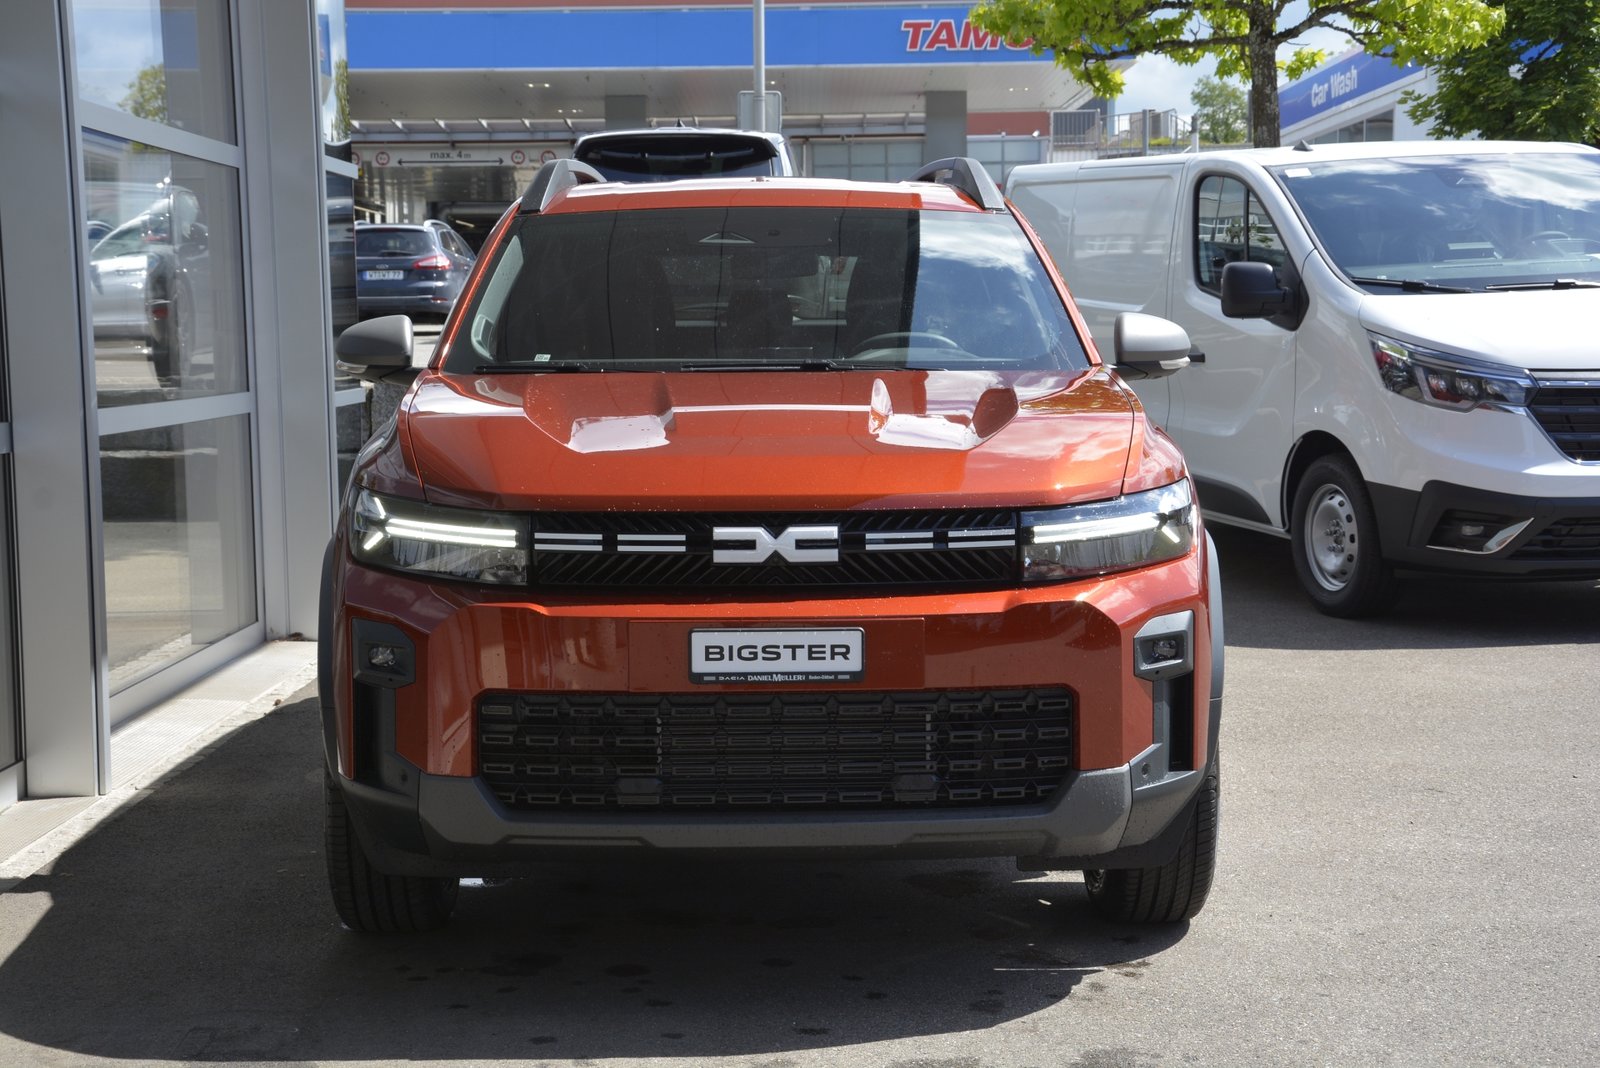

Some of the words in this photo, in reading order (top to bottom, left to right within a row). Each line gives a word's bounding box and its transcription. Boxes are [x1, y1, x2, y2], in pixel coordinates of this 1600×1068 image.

[1311, 82, 1329, 108] Car
[1330, 64, 1358, 99] Wash
[704, 643, 851, 662] BIGSTER
